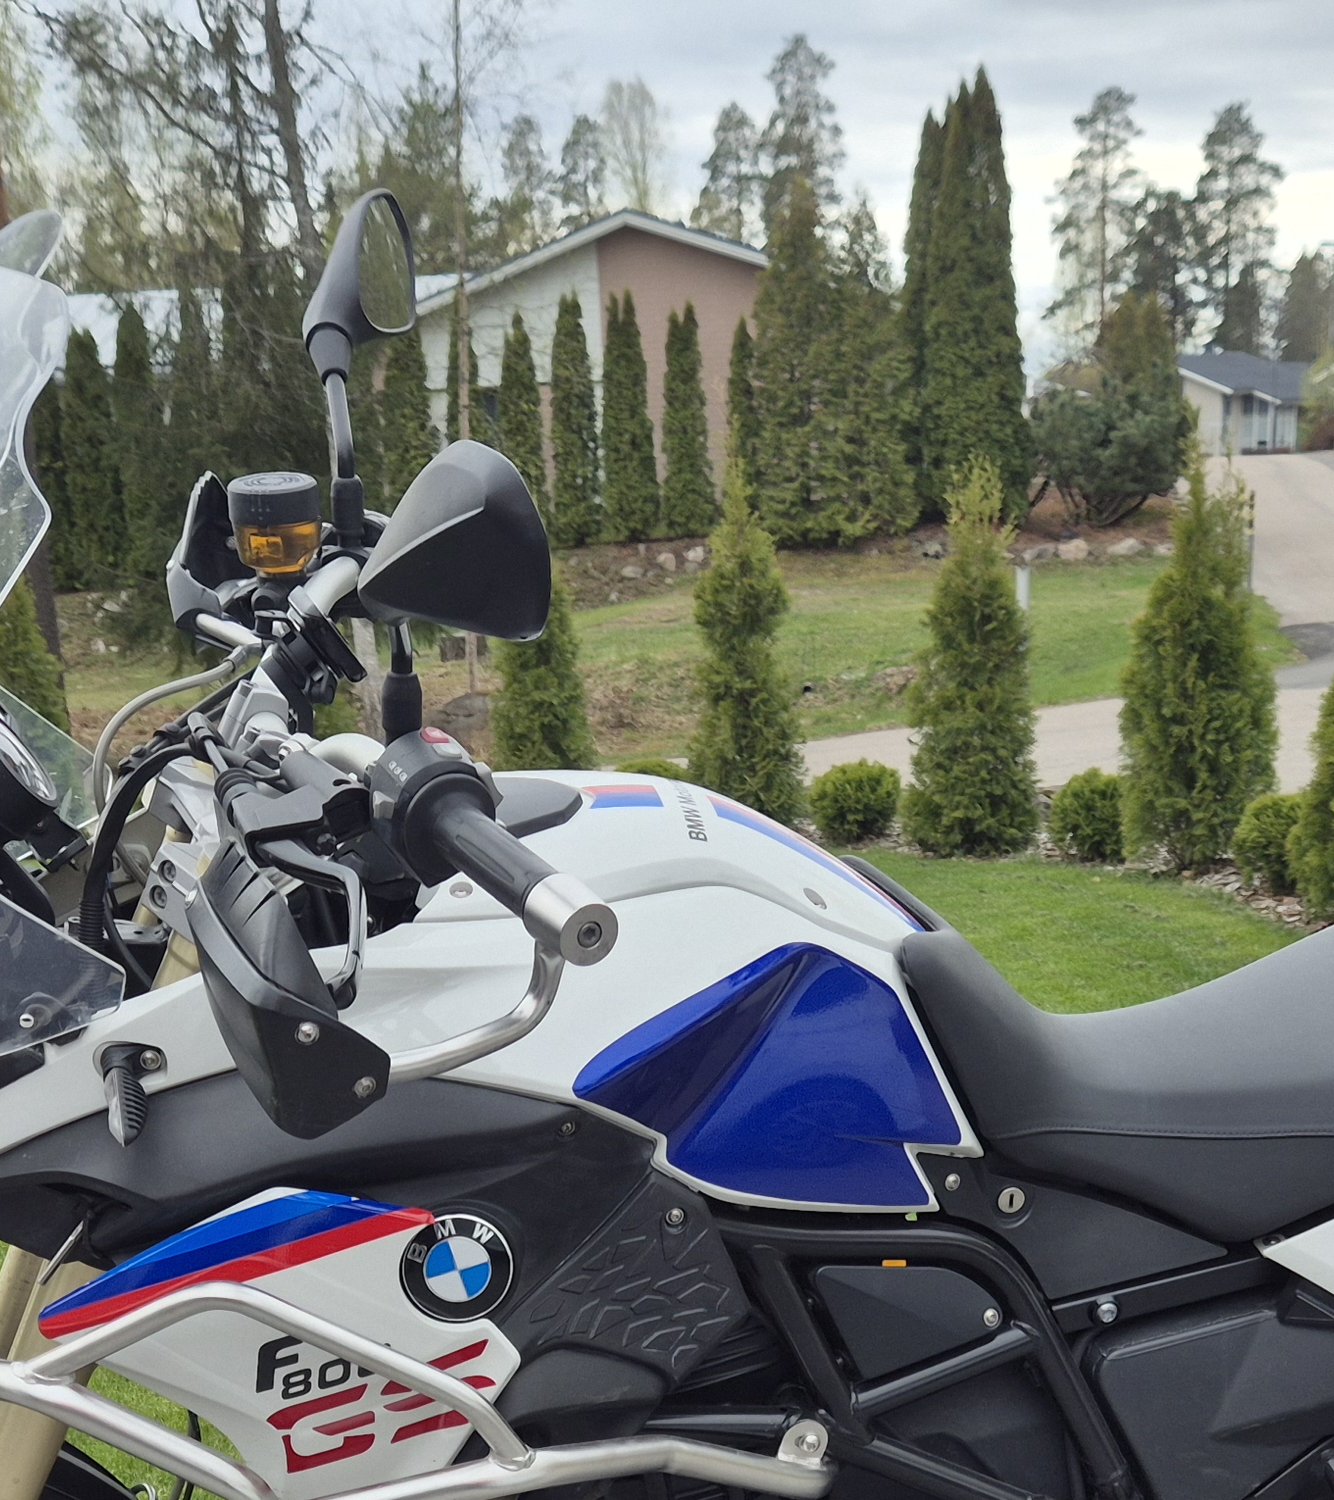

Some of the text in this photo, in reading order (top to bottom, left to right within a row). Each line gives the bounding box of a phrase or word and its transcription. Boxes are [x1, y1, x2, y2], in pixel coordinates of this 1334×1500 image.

[681, 806, 708, 842] BMW
[407, 1219, 494, 1264] BMW
[281, 1342, 392, 1400] 80
